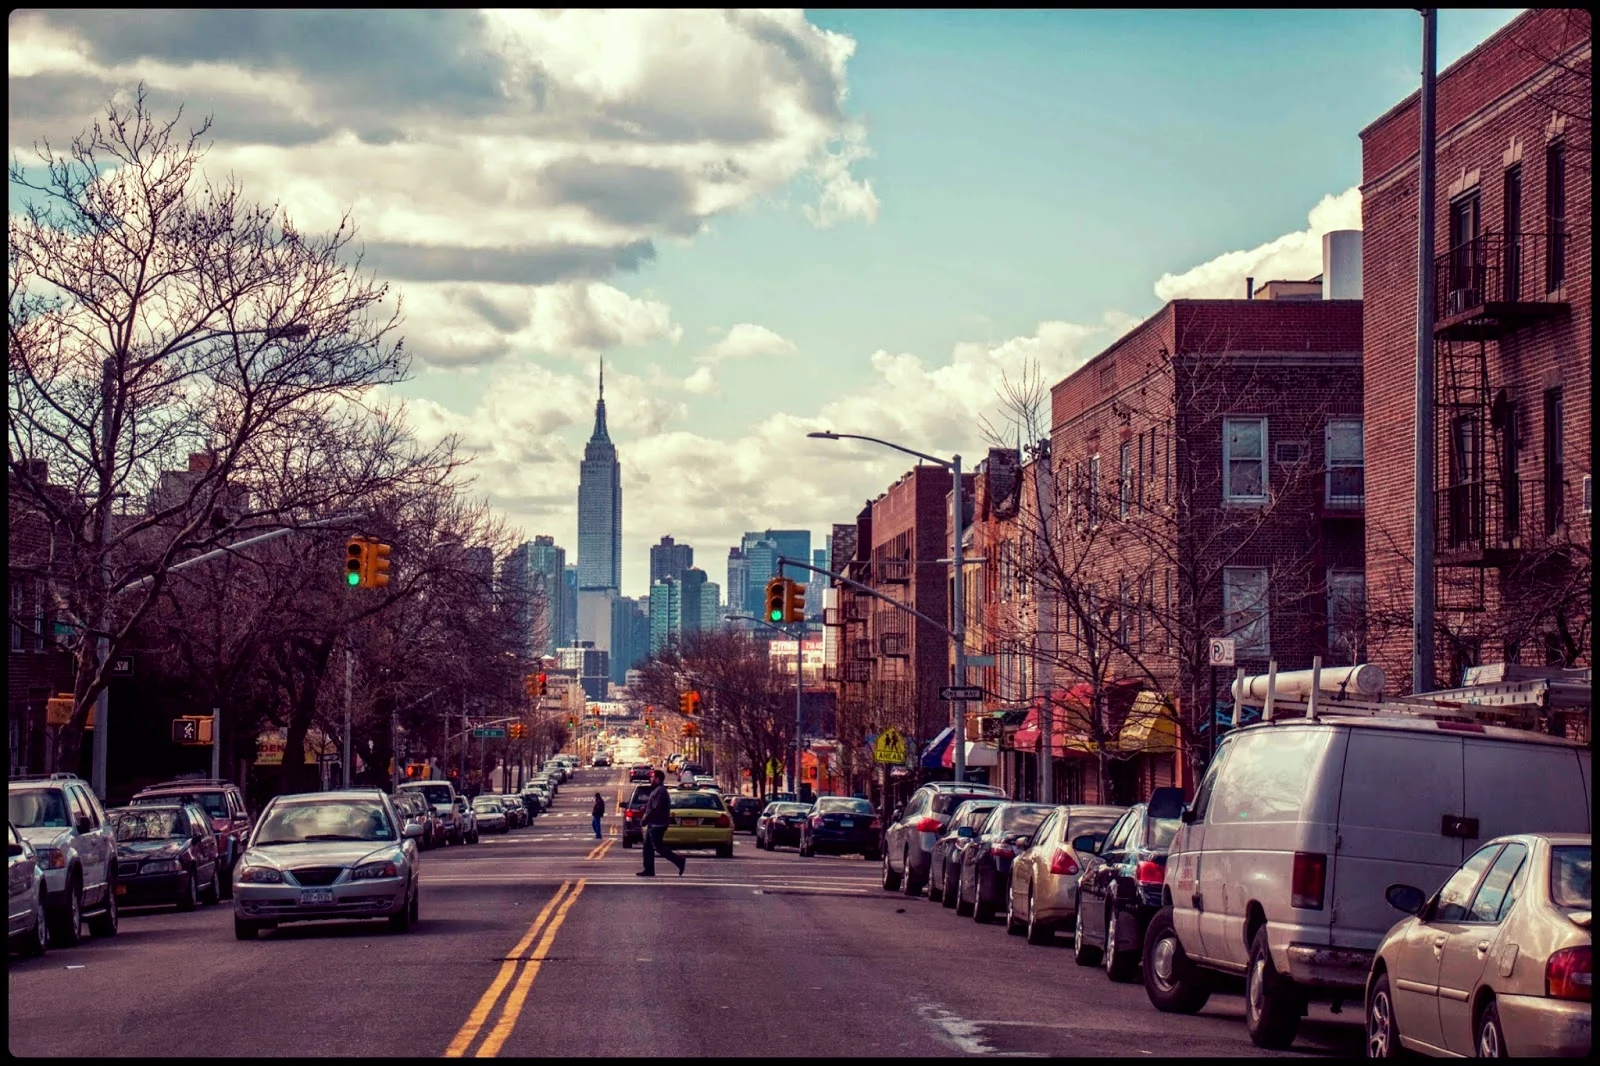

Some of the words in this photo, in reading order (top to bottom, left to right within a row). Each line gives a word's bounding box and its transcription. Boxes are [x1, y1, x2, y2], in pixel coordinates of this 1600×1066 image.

[945, 690, 957, 698] ONE
[964, 690, 977, 698] WAY
[878, 752, 903, 760] AHEAD
